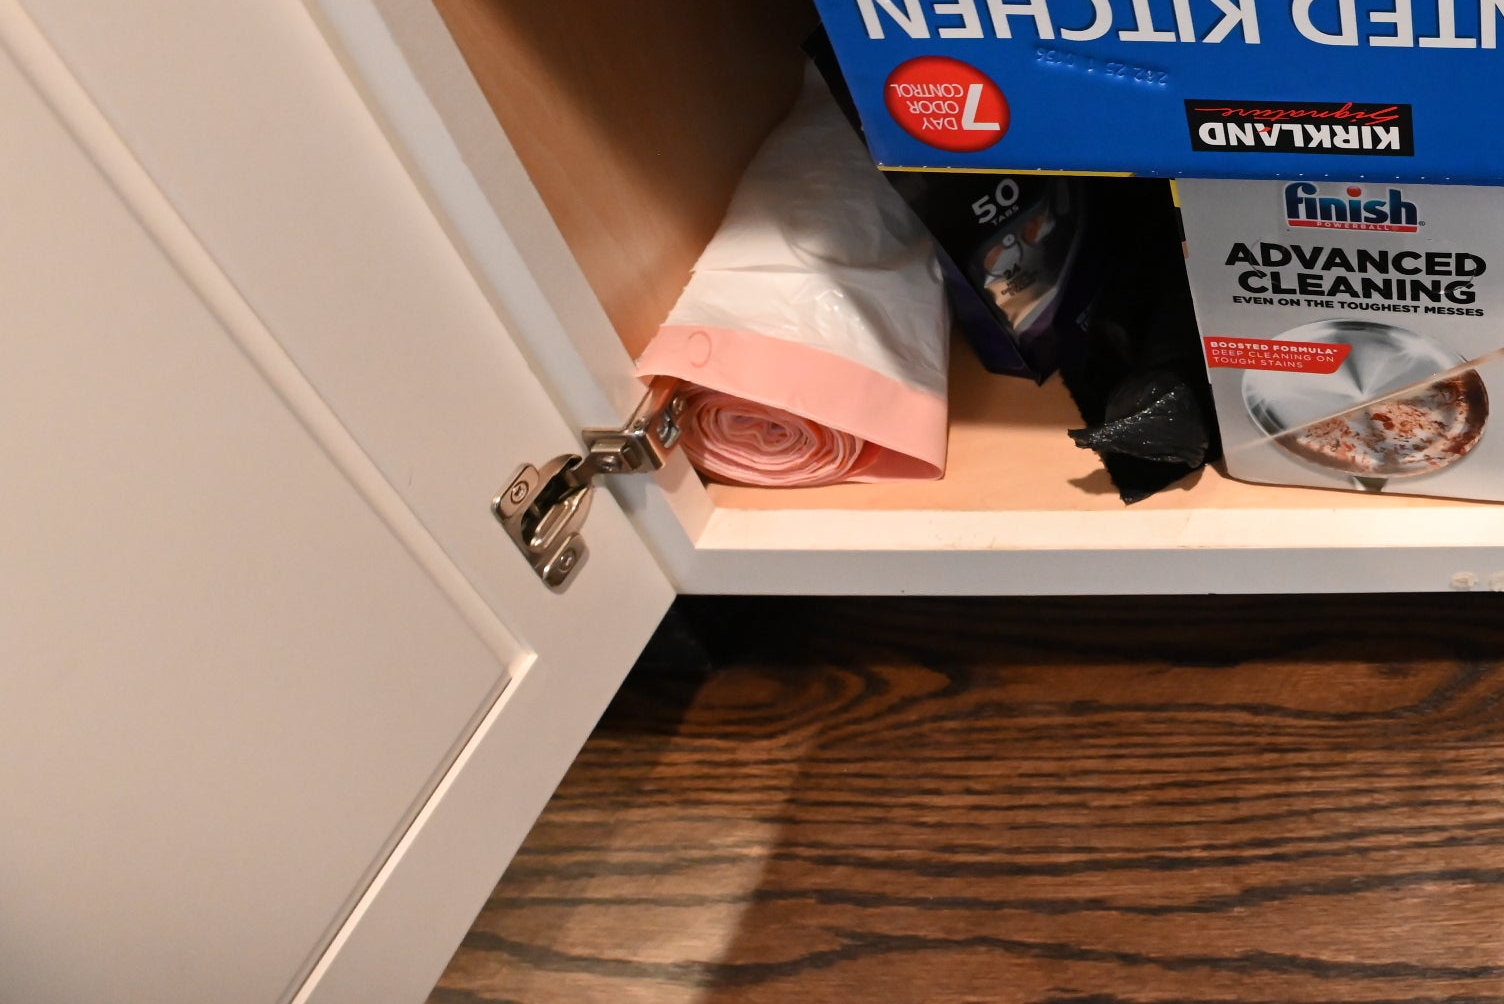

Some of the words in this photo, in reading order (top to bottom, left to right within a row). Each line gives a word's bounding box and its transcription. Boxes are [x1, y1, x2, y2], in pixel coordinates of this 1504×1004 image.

[890, 83, 964, 98] CONTROL
[906, 101, 959, 115] ODOR
[962, 84, 1001, 131] 7
[1194, 102, 1400, 126] Signature
[921, 117, 959, 131] DAY
[1199, 122, 1401, 150] KIRKLAND
[971, 178, 1020, 225] 50
[1285, 182, 1417, 225] finish
[1316, 221, 1391, 231] POWERBALL
[1225, 242, 1487, 278] ADVANCED
[1238, 269, 1476, 305] CLEANING
[1232, 295, 1274, 306] EVEN
[1278, 298, 1301, 307] ON
[1304, 299, 1334, 309] THE
[1338, 300, 1420, 314] TOUGHEST
[1424, 305, 1484, 318] MESSES
[1210, 341, 1269, 351] BOOSTED
[1212, 349, 1244, 357] DEEP
[1248, 351, 1312, 362] CLEANING
[1316, 355, 1335, 363] ON
[1214, 357, 1256, 366] TOUGH
[1260, 360, 1303, 369] STAINS
